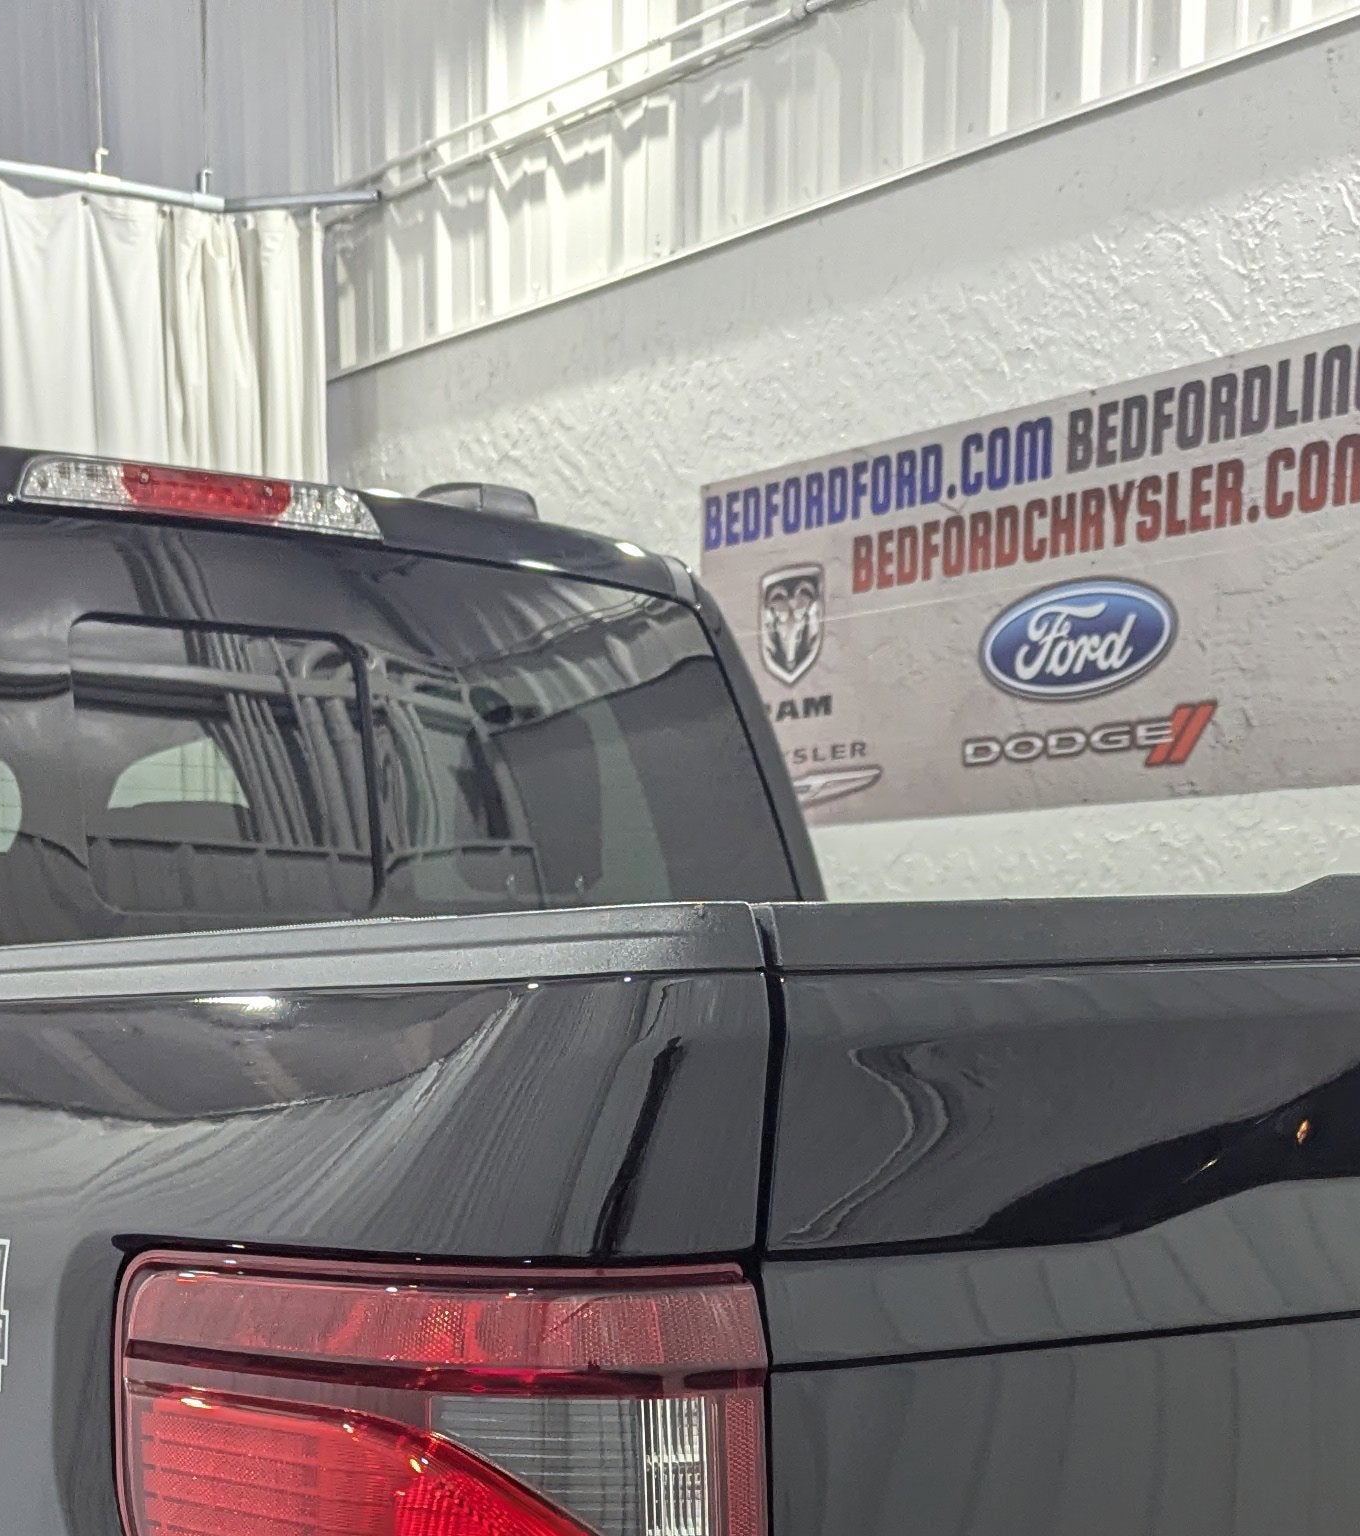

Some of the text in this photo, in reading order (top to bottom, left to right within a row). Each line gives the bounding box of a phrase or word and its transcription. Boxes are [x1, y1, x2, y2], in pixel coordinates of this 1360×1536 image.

[704, 415, 1054, 552] BEDFORDFORD.COM
[1013, 600, 1139, 682] Ford
[764, 694, 834, 723] AM
[962, 715, 1177, 768] DODGE
